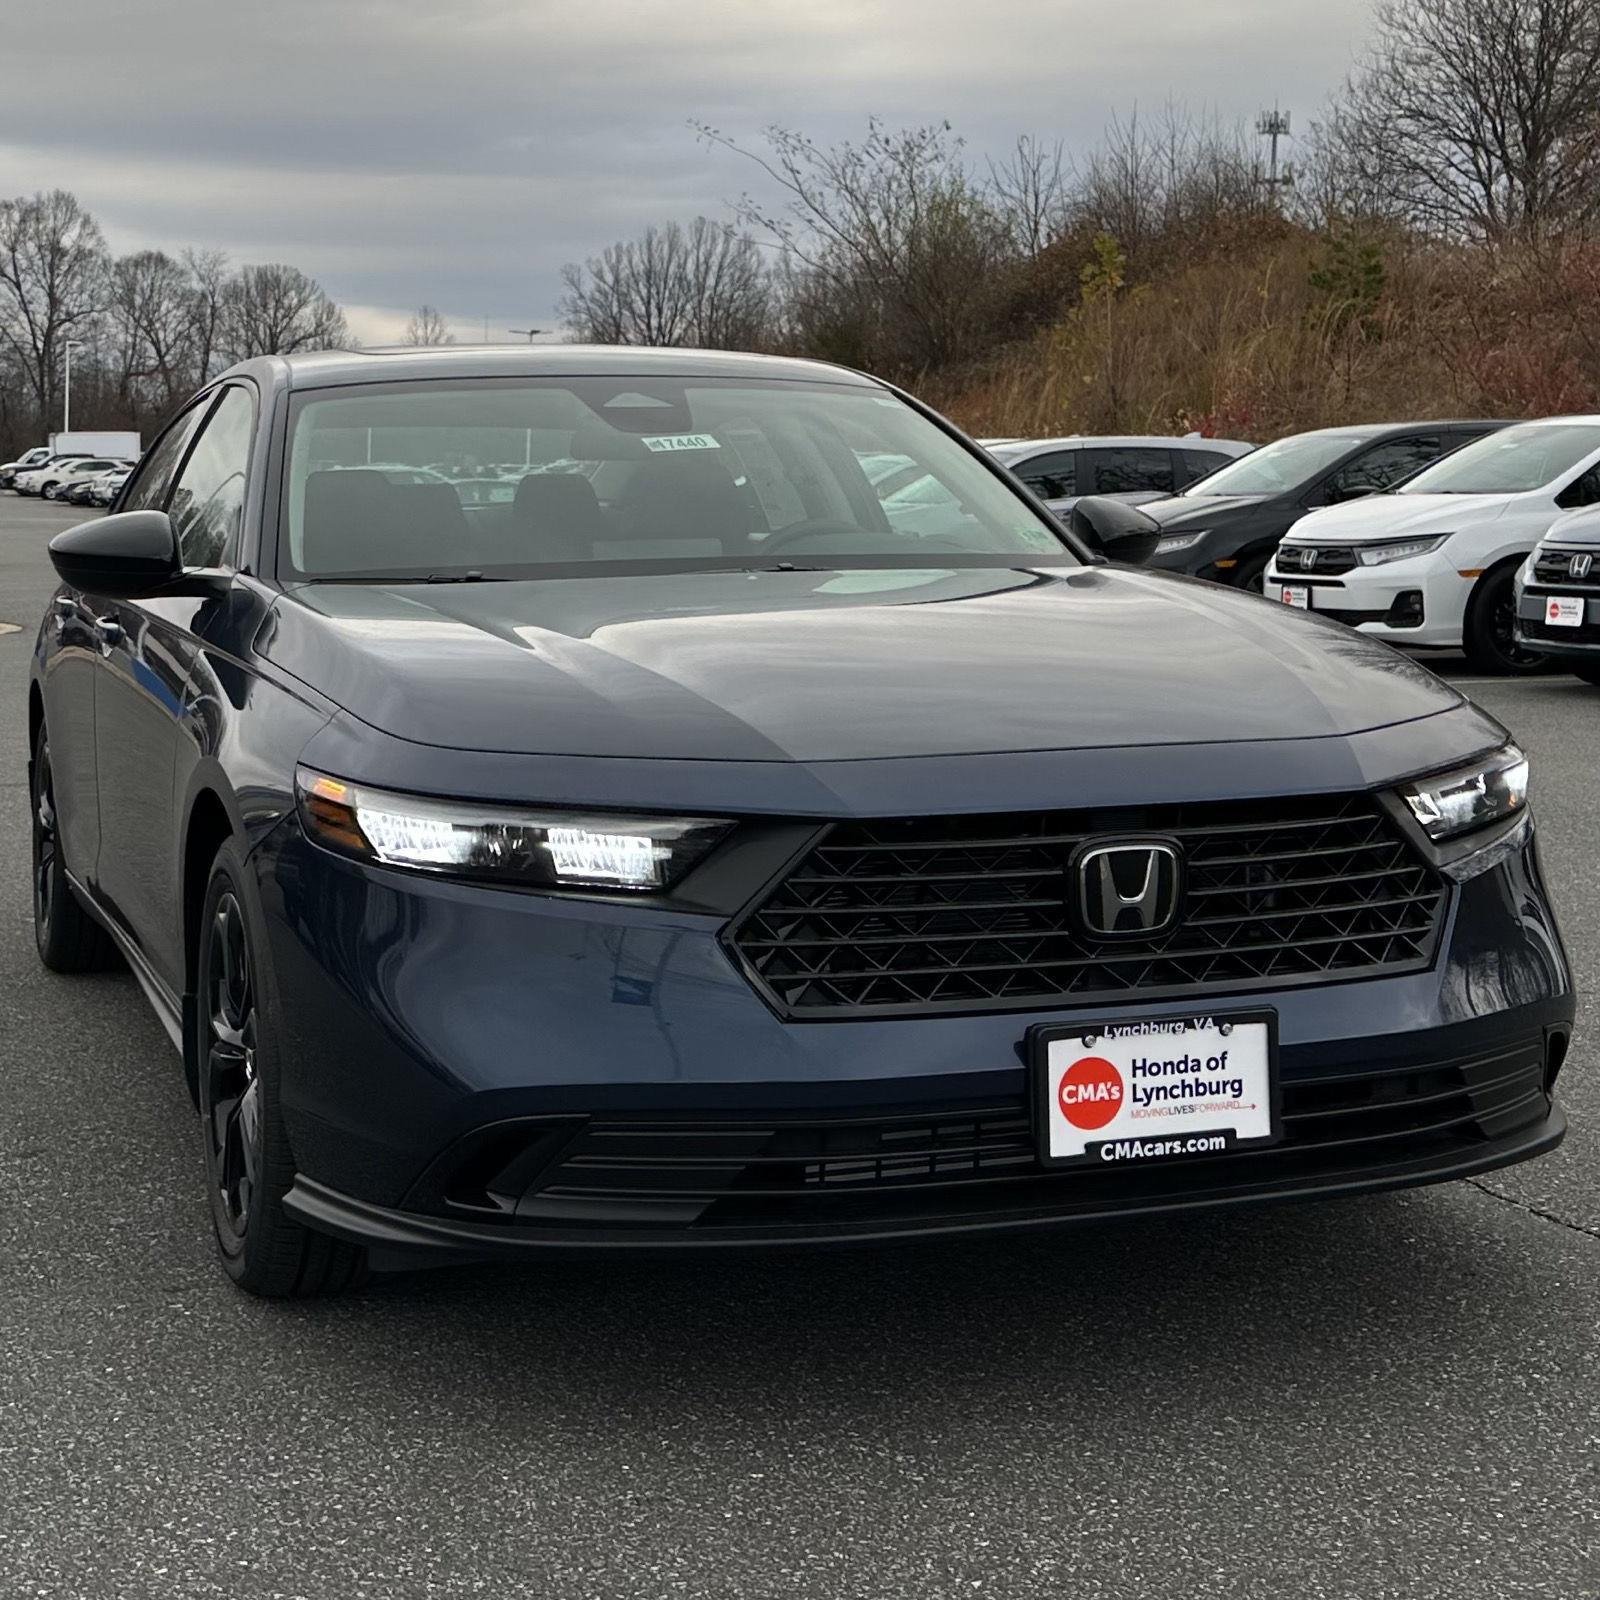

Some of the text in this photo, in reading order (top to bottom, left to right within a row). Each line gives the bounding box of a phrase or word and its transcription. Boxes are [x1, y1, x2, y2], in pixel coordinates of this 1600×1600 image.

[1193, 1017, 1215, 1031] VA
[1131, 1050, 1228, 1078] Honda of
[1062, 1081, 1120, 1104] CMA's
[1132, 1078, 1243, 1107] Lynchburg
[1100, 1136, 1226, 1161] CMAcars.com
